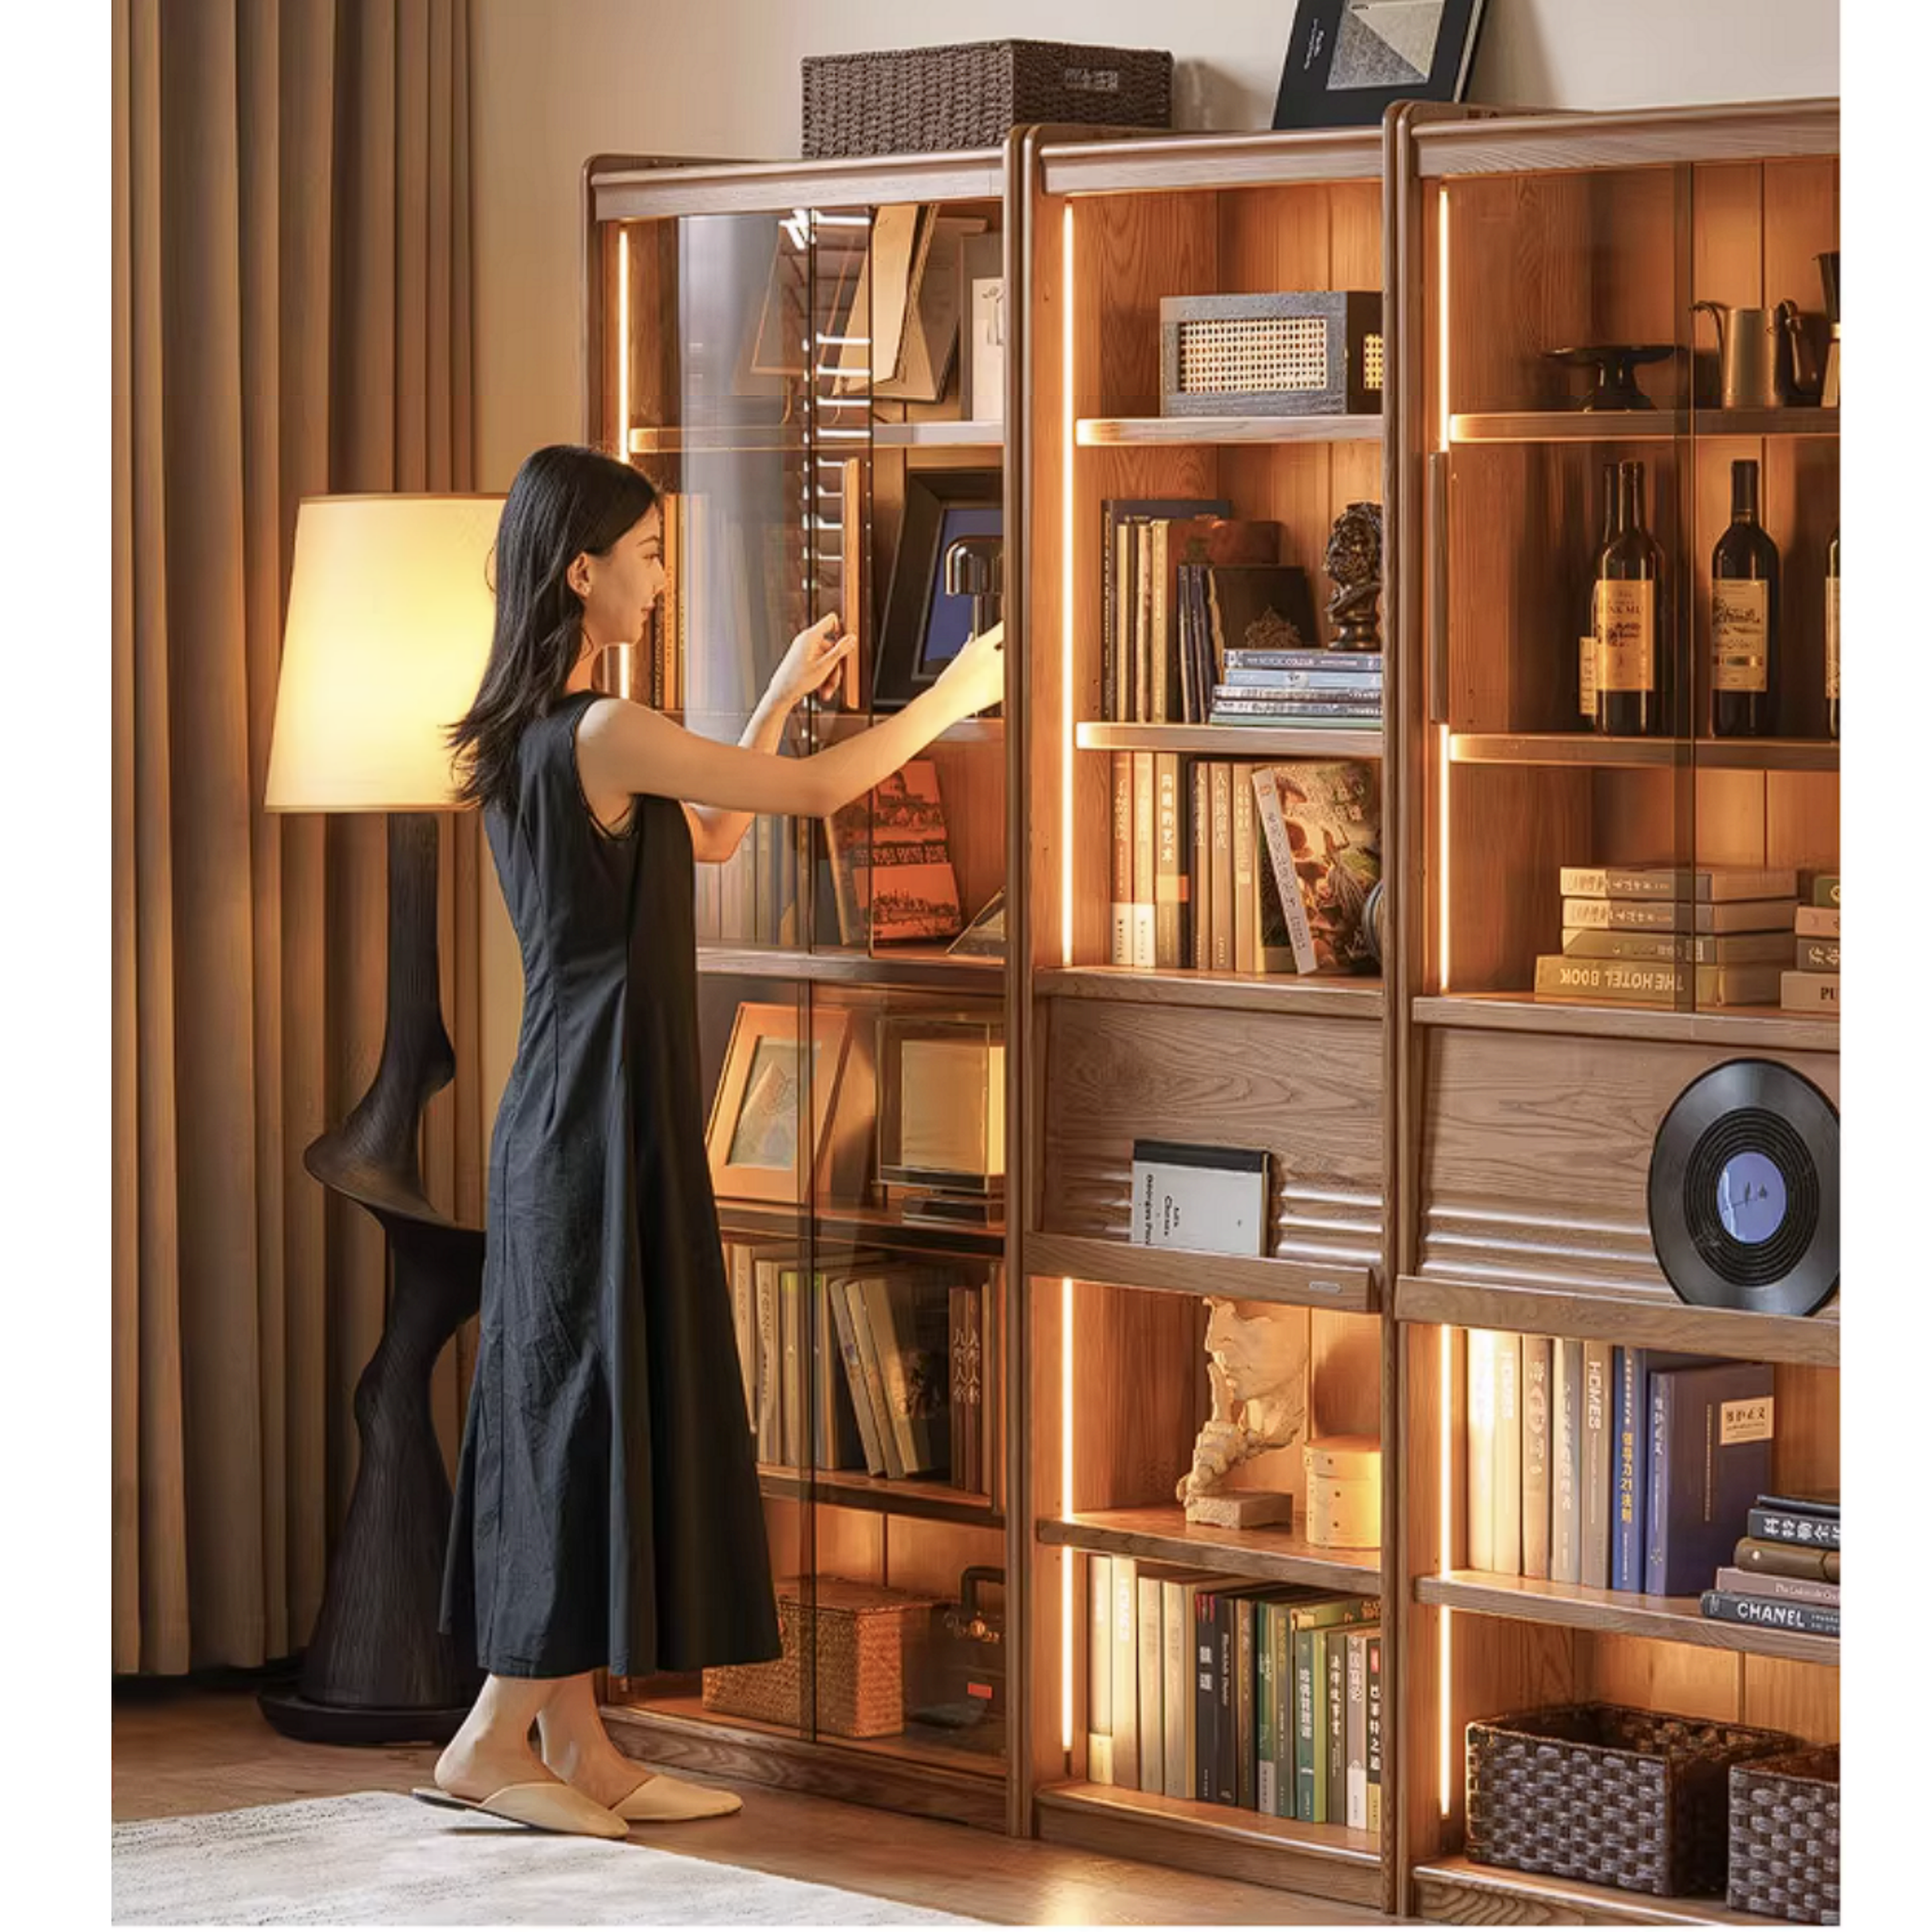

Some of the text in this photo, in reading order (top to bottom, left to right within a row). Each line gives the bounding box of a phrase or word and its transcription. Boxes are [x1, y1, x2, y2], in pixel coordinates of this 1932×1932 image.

[1559, 967, 1684, 992] THE HOTEL BOOK
[1737, 1602, 1805, 1628] CHANEL
